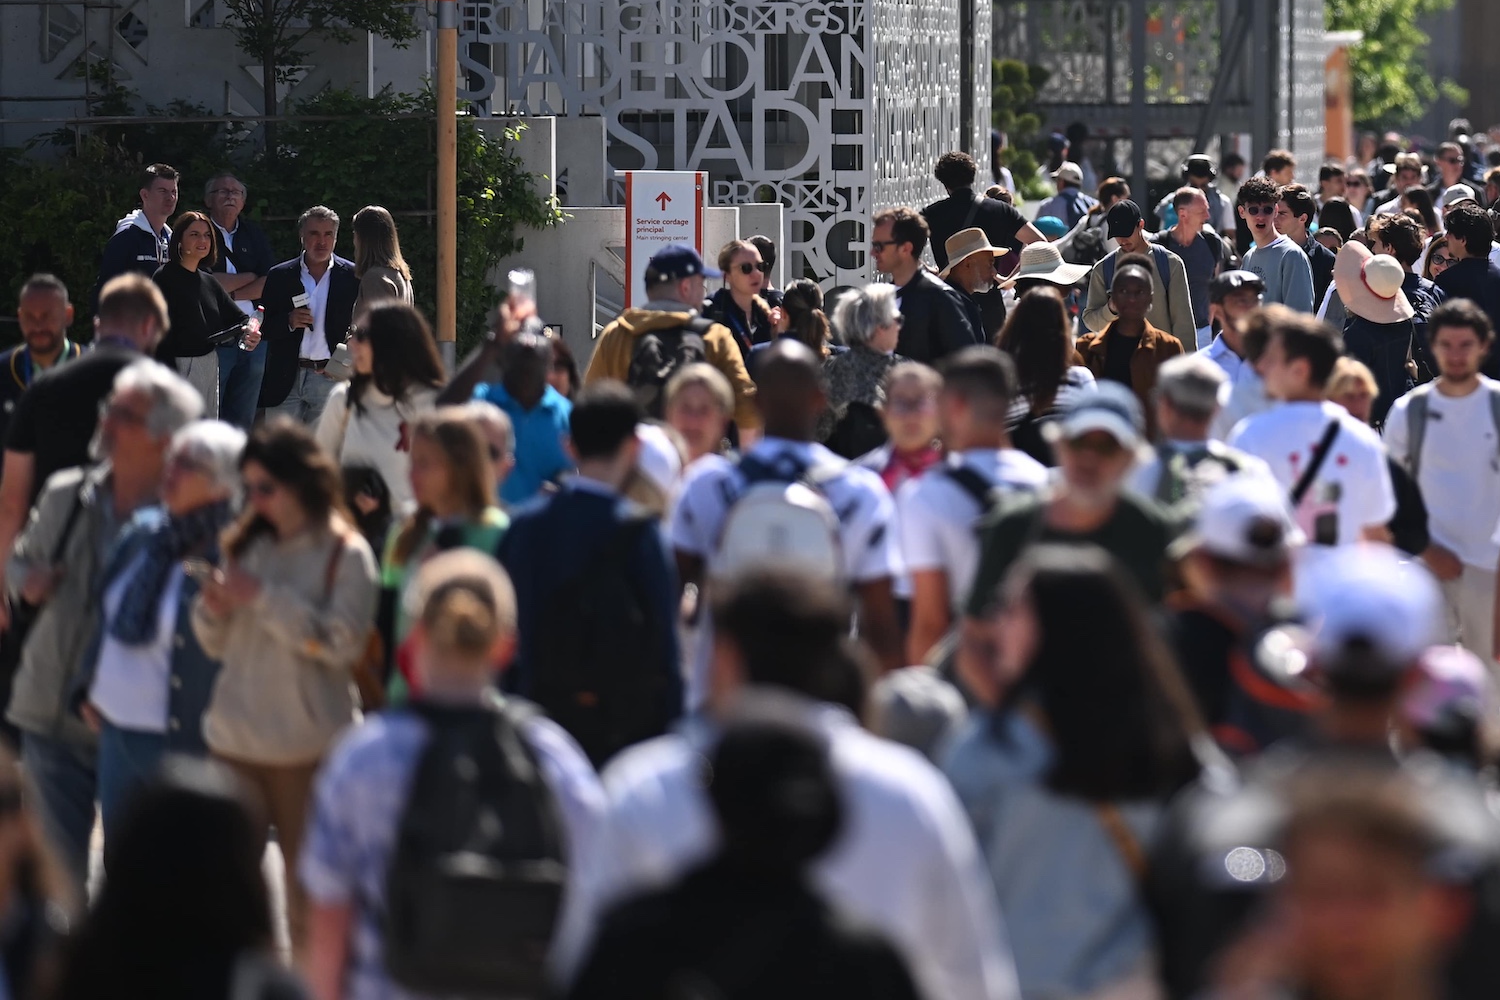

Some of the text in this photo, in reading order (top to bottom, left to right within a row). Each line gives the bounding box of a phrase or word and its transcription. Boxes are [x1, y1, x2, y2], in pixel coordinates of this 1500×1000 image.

[605, 98, 864, 182] STADE
[662, 218, 689, 227] cordage
[636, 226, 665, 234] principal
